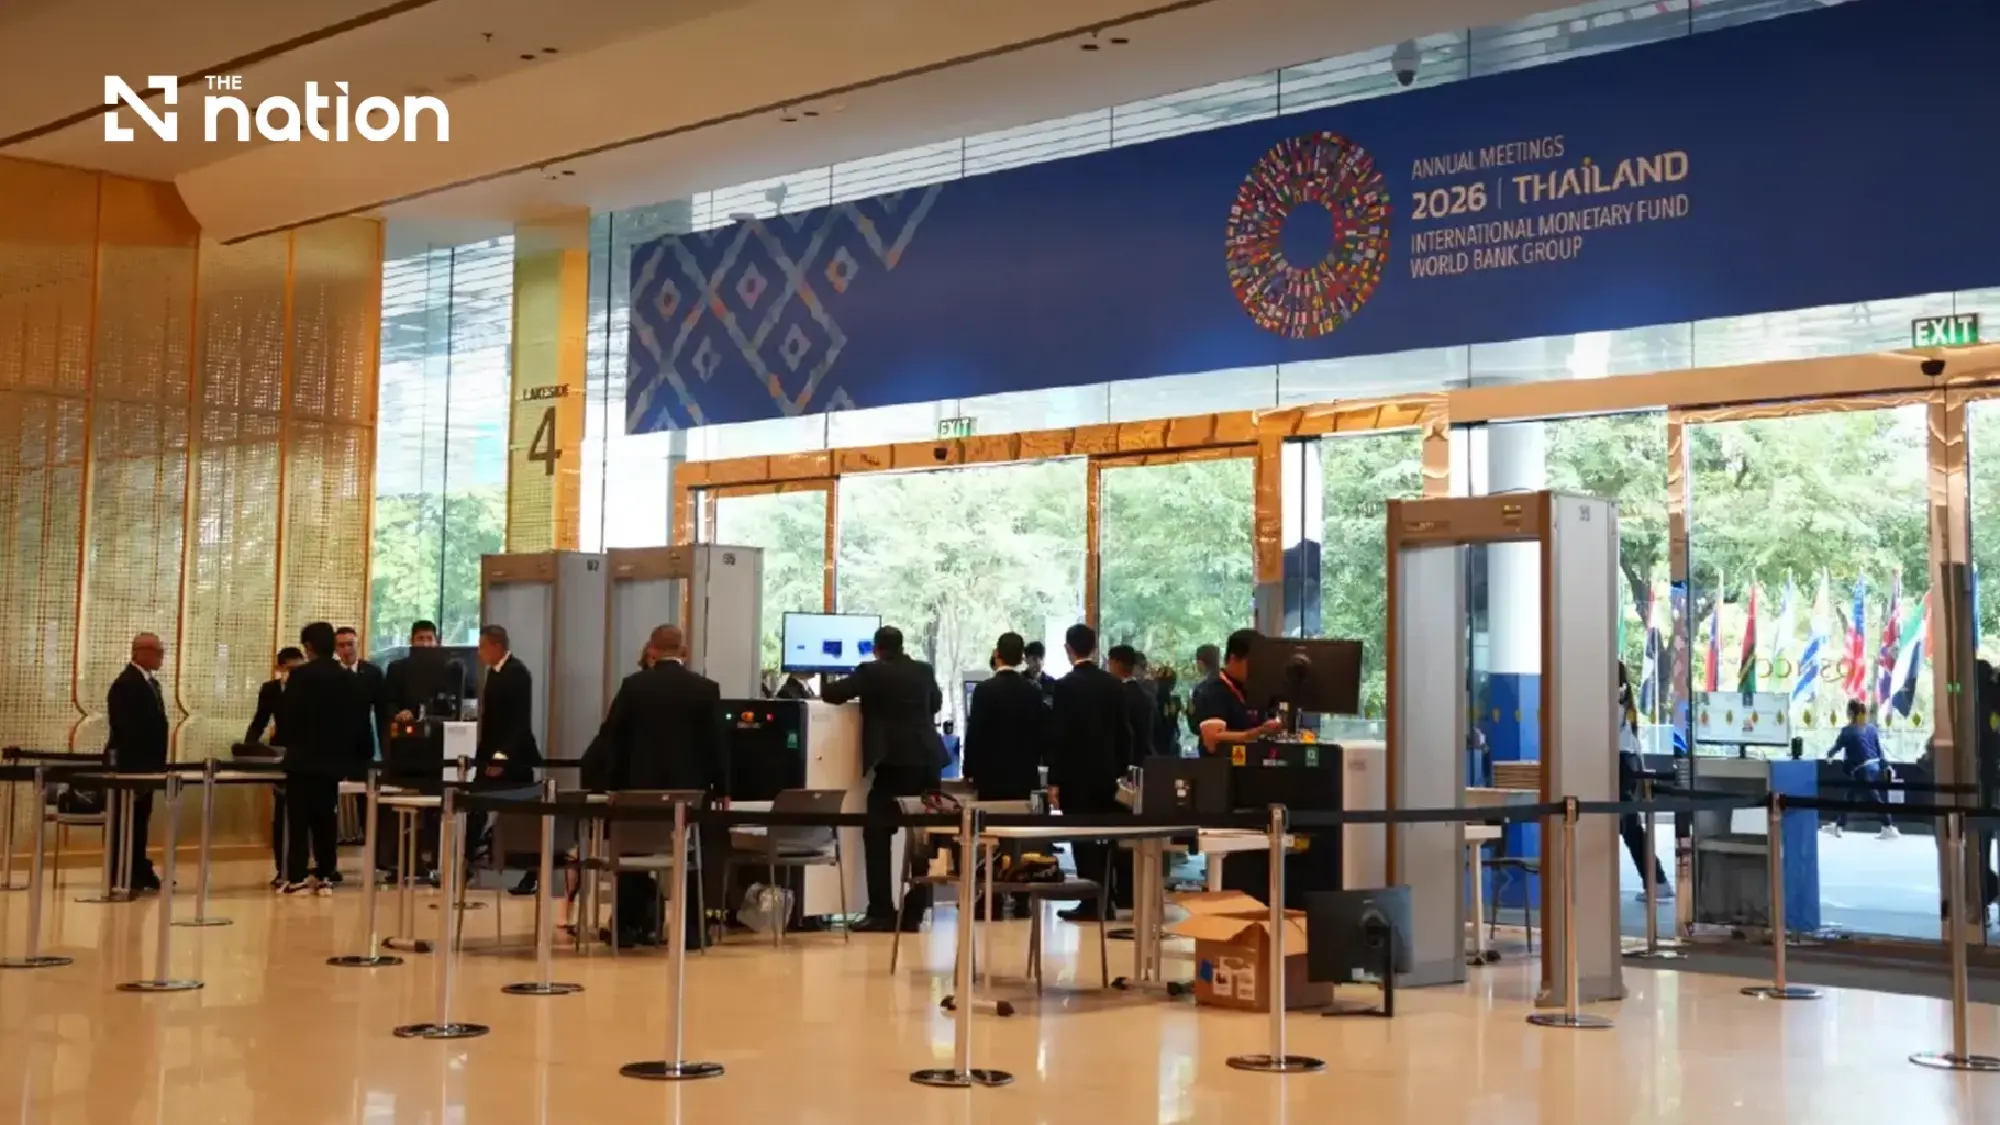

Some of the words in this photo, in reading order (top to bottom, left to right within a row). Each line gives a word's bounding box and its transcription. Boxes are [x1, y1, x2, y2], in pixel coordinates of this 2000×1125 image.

[1411, 149, 1477, 180] ANNUAL
[1479, 135, 1565, 168] MEETINGS
[1411, 181, 1488, 220] 2026
[1410, 219, 1536, 254] INTERNATIONAL
[1537, 201, 1635, 237] MONETARY
[1636, 193, 1690, 223] FUND
[1410, 252, 1470, 279] WORLD
[1473, 243, 1519, 270] BANK
[1521, 235, 1583, 265] GROUP
[1914, 315, 1973, 347] EXIT
[522, 382, 570, 401] LAKESIDE
[528, 405, 563, 477] 4
